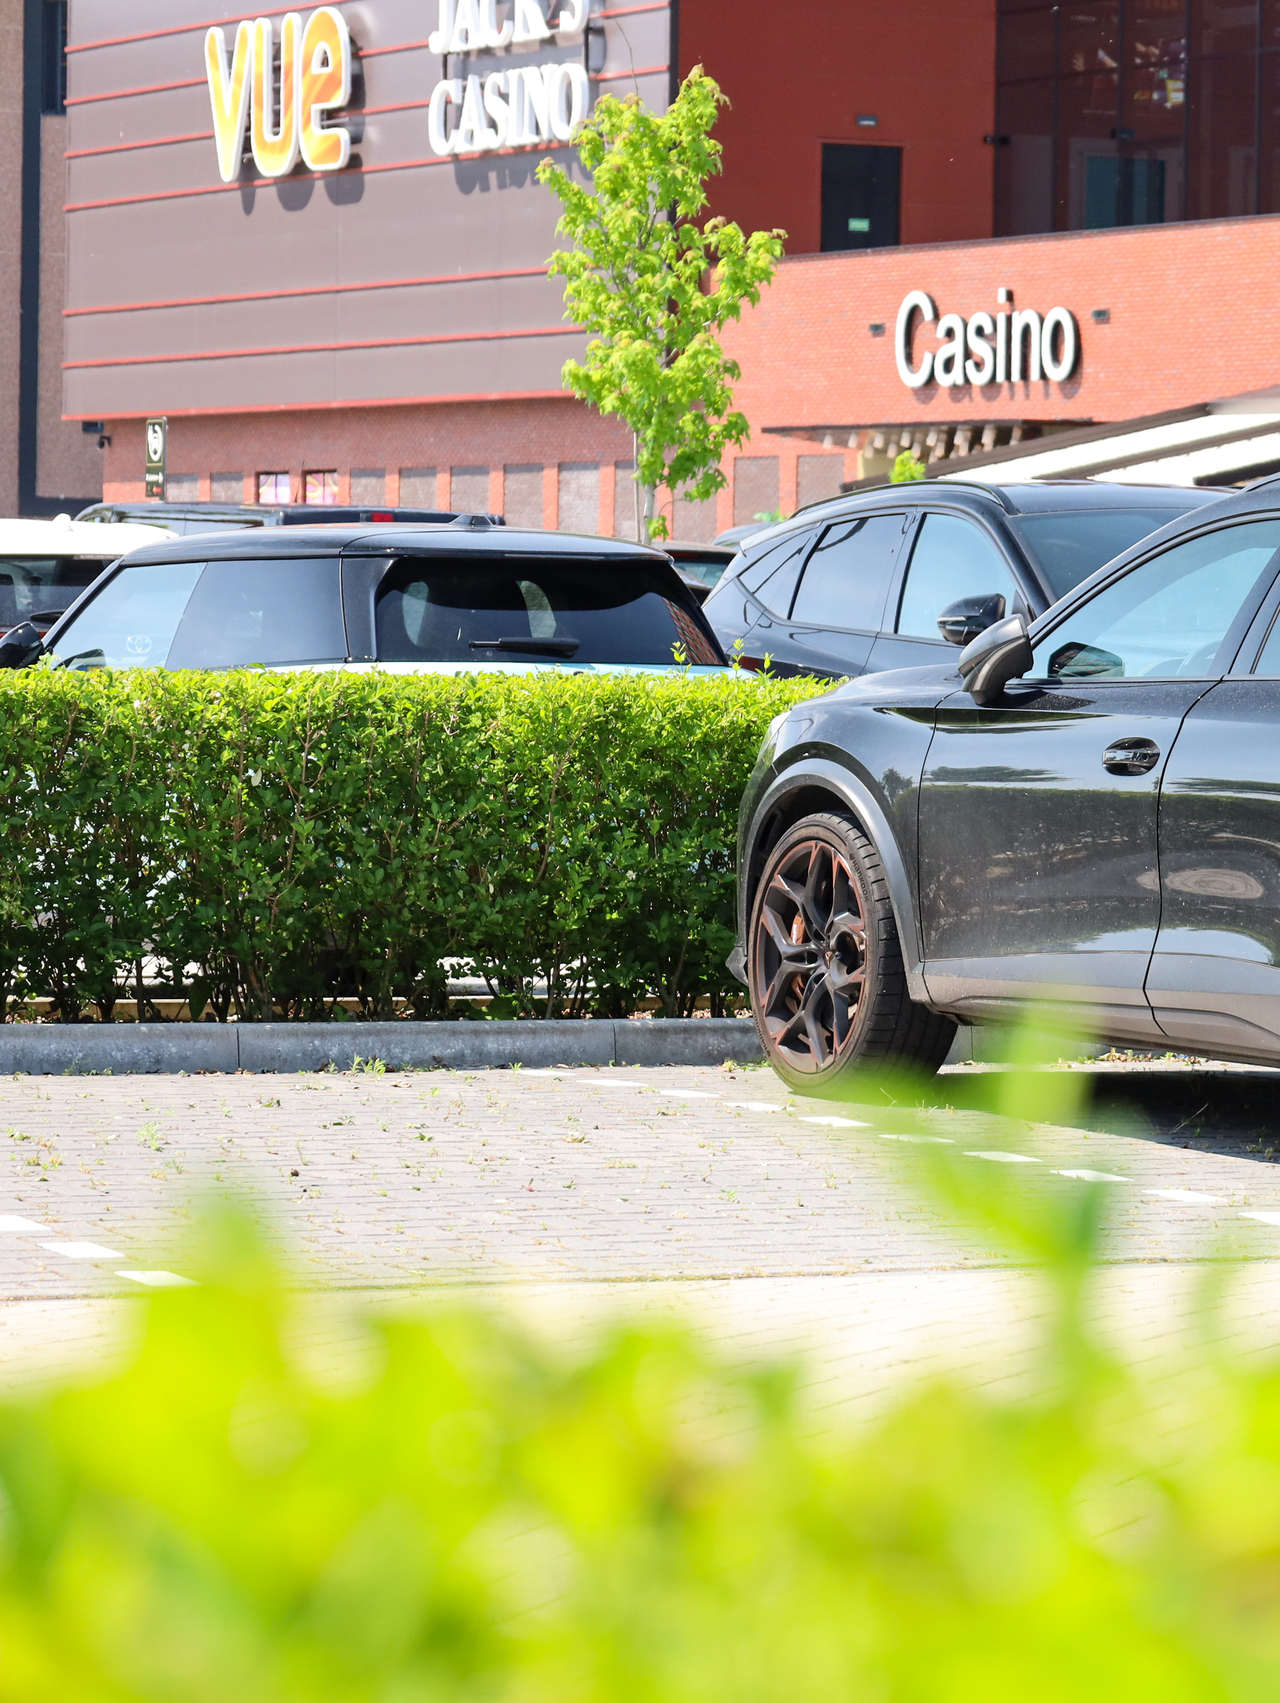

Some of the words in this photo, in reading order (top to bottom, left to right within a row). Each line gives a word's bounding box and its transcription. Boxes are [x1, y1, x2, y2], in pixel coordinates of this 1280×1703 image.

[429, 0, 589, 55] JACK
[428, 62, 589, 156] CASINO
[895, 287, 1076, 389] Casino
